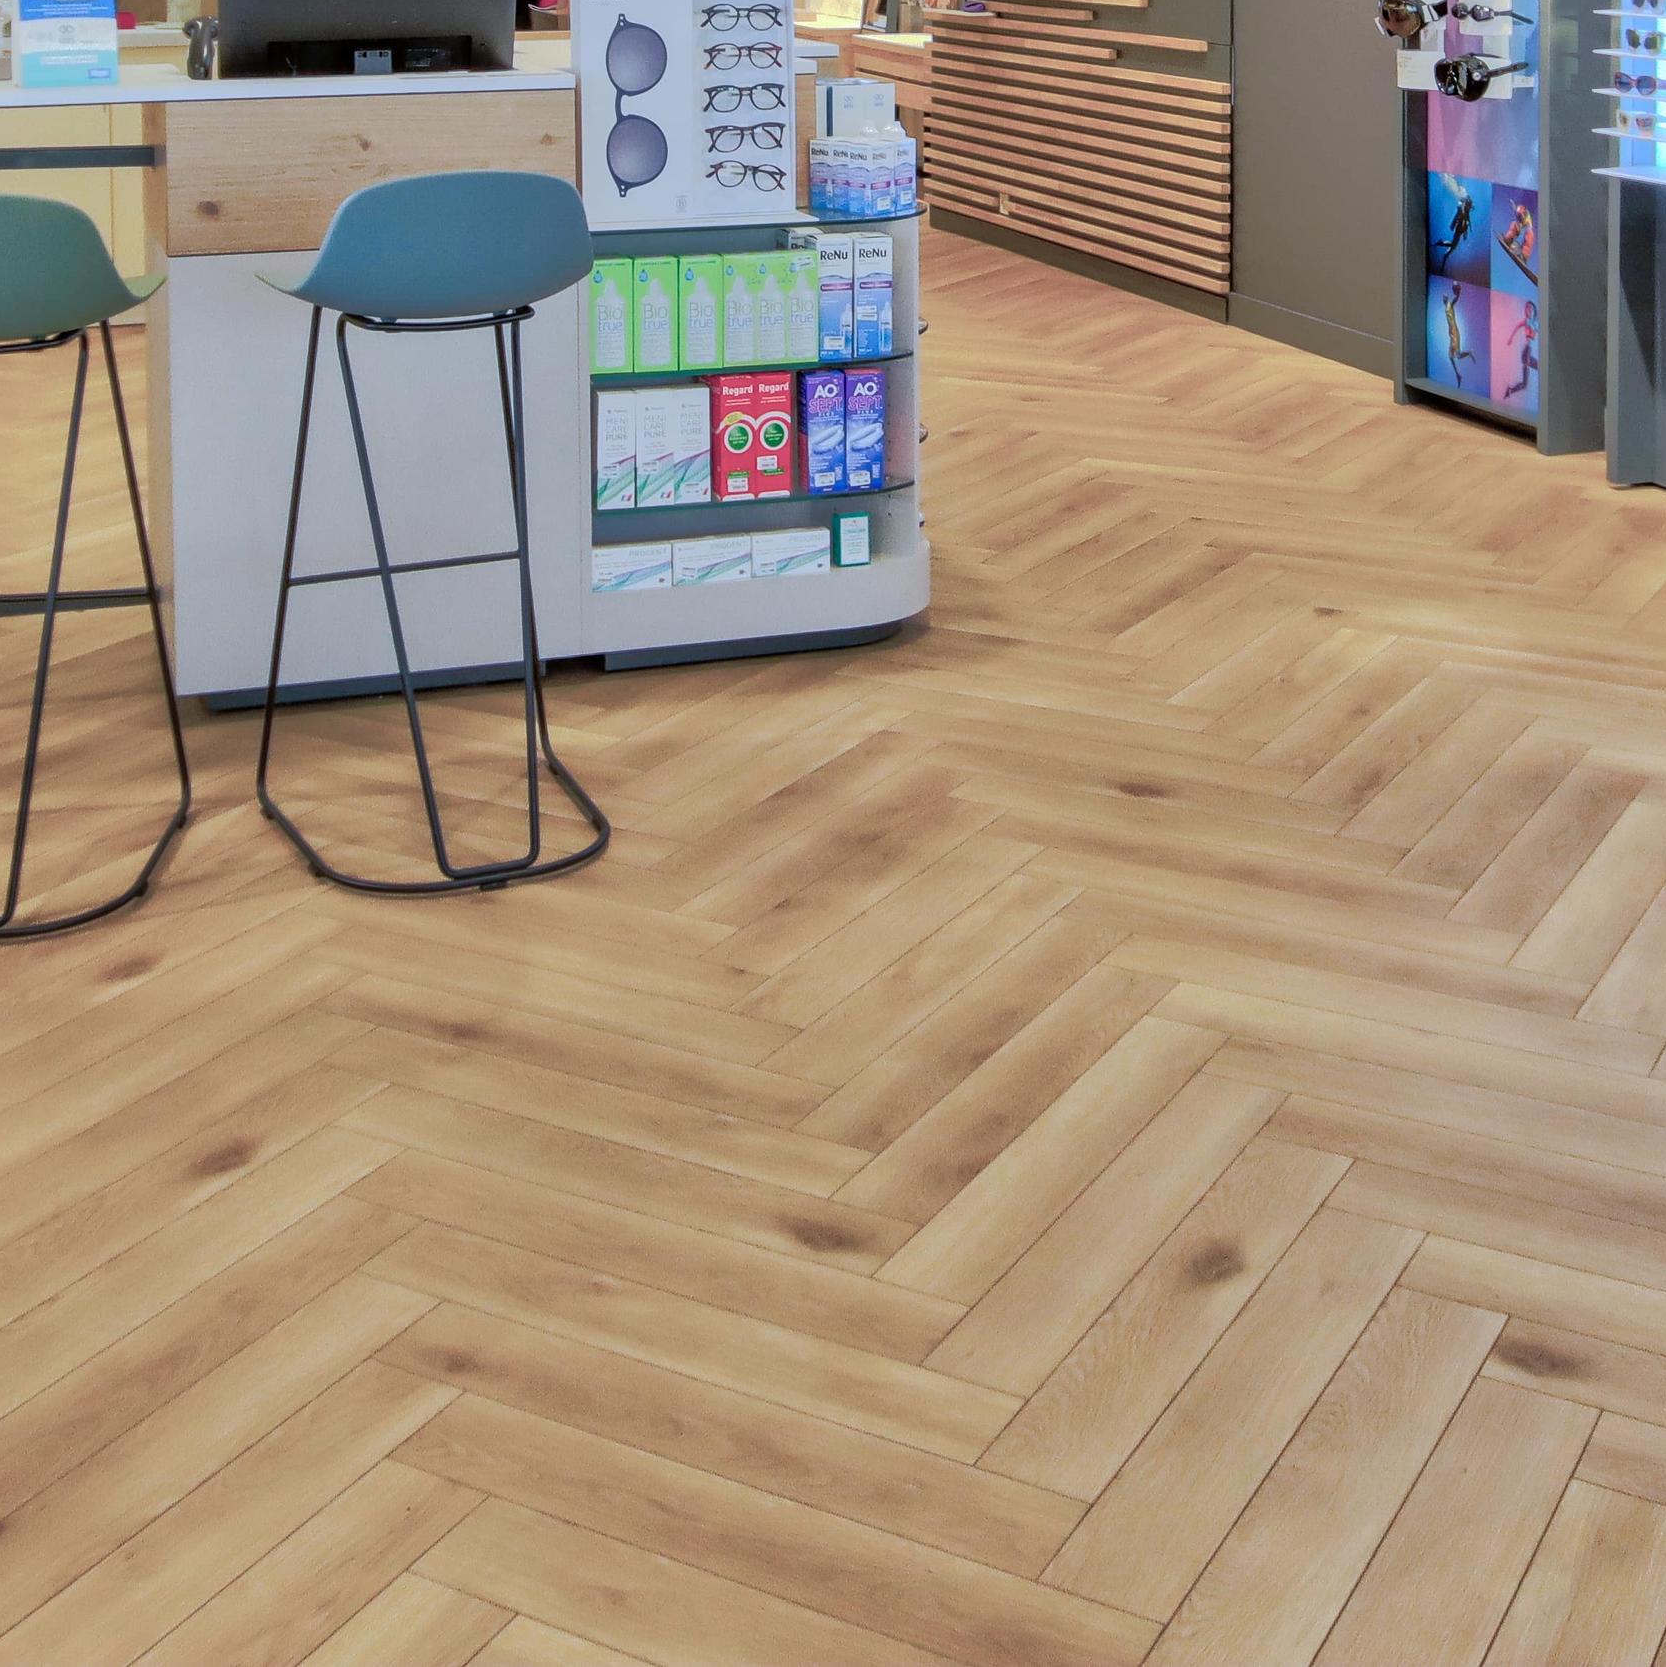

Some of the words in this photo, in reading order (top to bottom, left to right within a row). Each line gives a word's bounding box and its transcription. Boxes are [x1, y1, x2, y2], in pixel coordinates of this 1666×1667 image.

[811, 147, 829, 157] ReNu
[850, 151, 868, 161] ReNu
[820, 250, 848, 261] ReNu
[858, 247, 887, 259] ReNu
[597, 304, 623, 321] Bio
[643, 302, 668, 319] Bio
[689, 301, 714, 318] Bio
[727, 300, 752, 315] Bio
[760, 299, 783, 314] Bio
[791, 298, 814, 313] Bio
[722, 385, 754, 397] Regard
[758, 382, 789, 394] Regard
[814, 383, 838, 398] AO
[853, 381, 878, 396] AO
[808, 397, 843, 413] SEPT
[847, 395, 883, 411] SEPT
